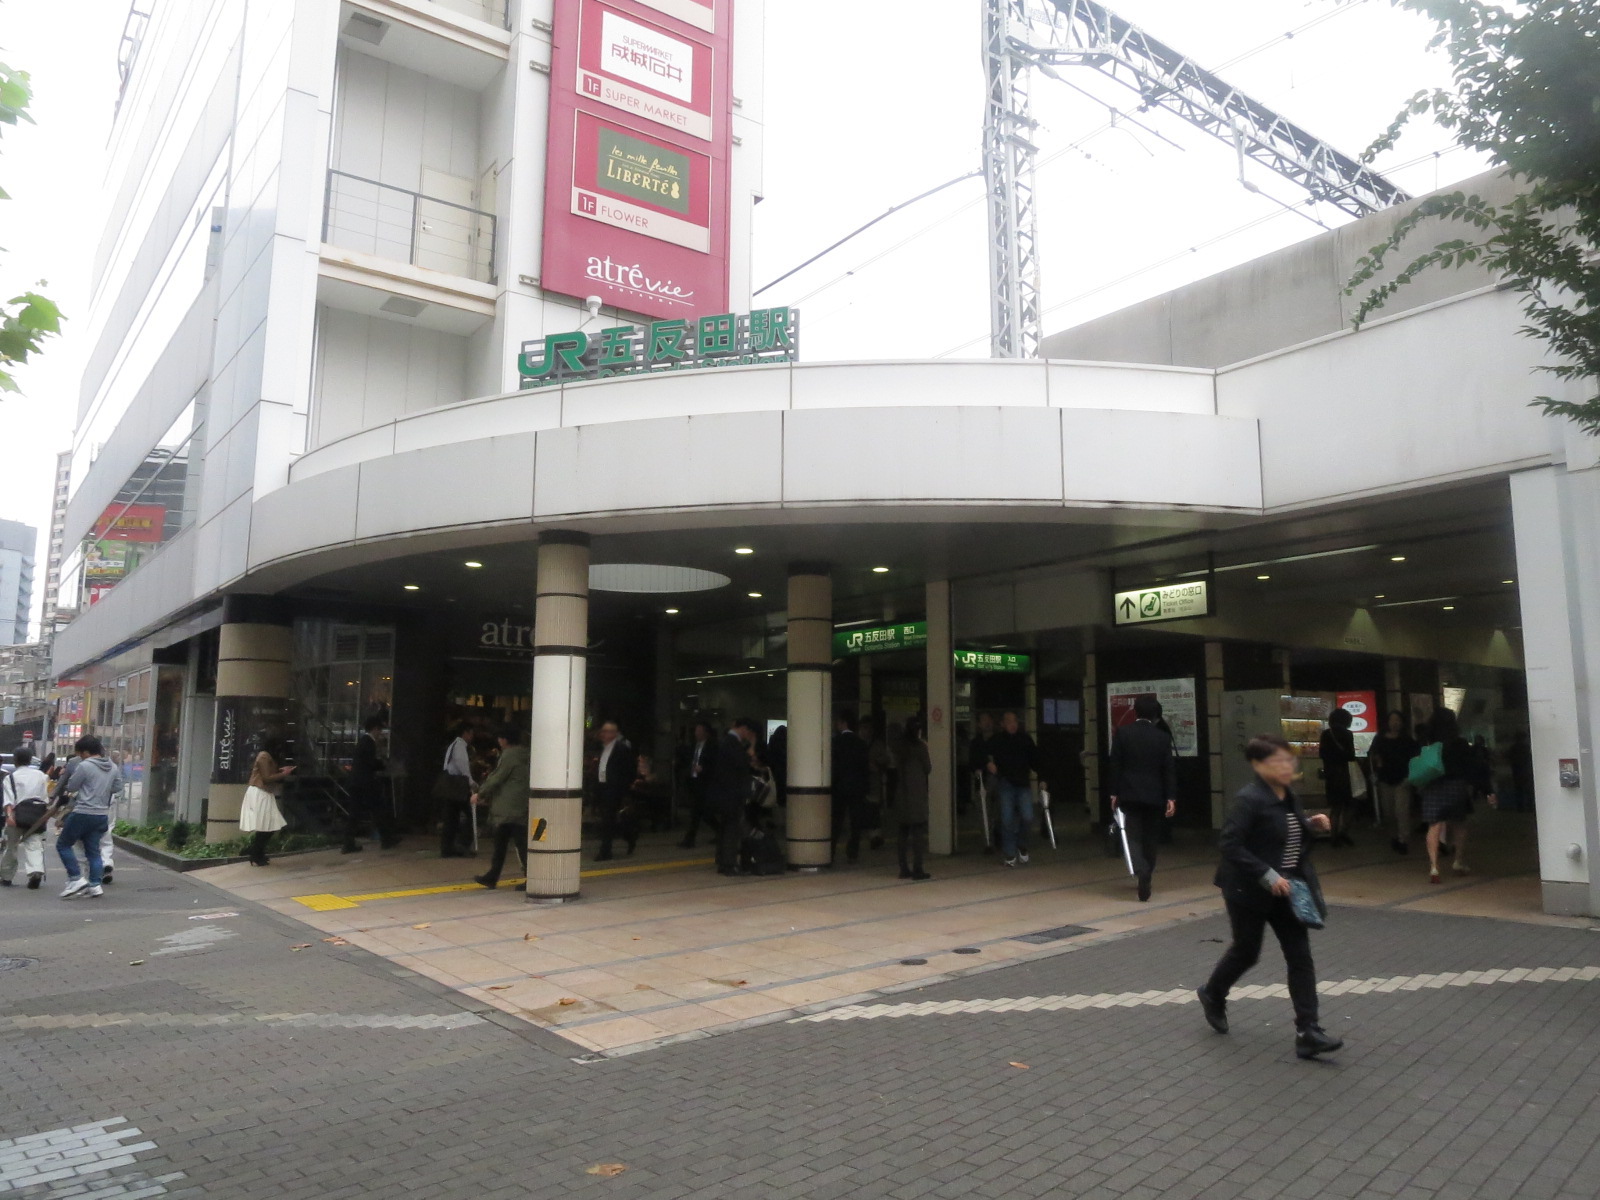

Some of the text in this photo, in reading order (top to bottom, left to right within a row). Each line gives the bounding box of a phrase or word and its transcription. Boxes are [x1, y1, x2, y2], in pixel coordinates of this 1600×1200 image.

[622, 35, 673, 61] SUPERMARKET
[611, 43, 683, 83] 成城石井
[587, 78, 687, 126] 1F SUPER MARKET
[611, 145, 623, 157] les
[583, 196, 649, 228] 1F FLOWER
[517, 306, 791, 377] JR 五反田駅
[1162, 585, 1202, 599] みどりの窓口
[846, 632, 863, 648] JR
[864, 628, 896, 643] 五反田駅
[903, 625, 915, 635] 西口
[962, 652, 977, 665] JR
[977, 654, 1002, 664] 五反田駅
